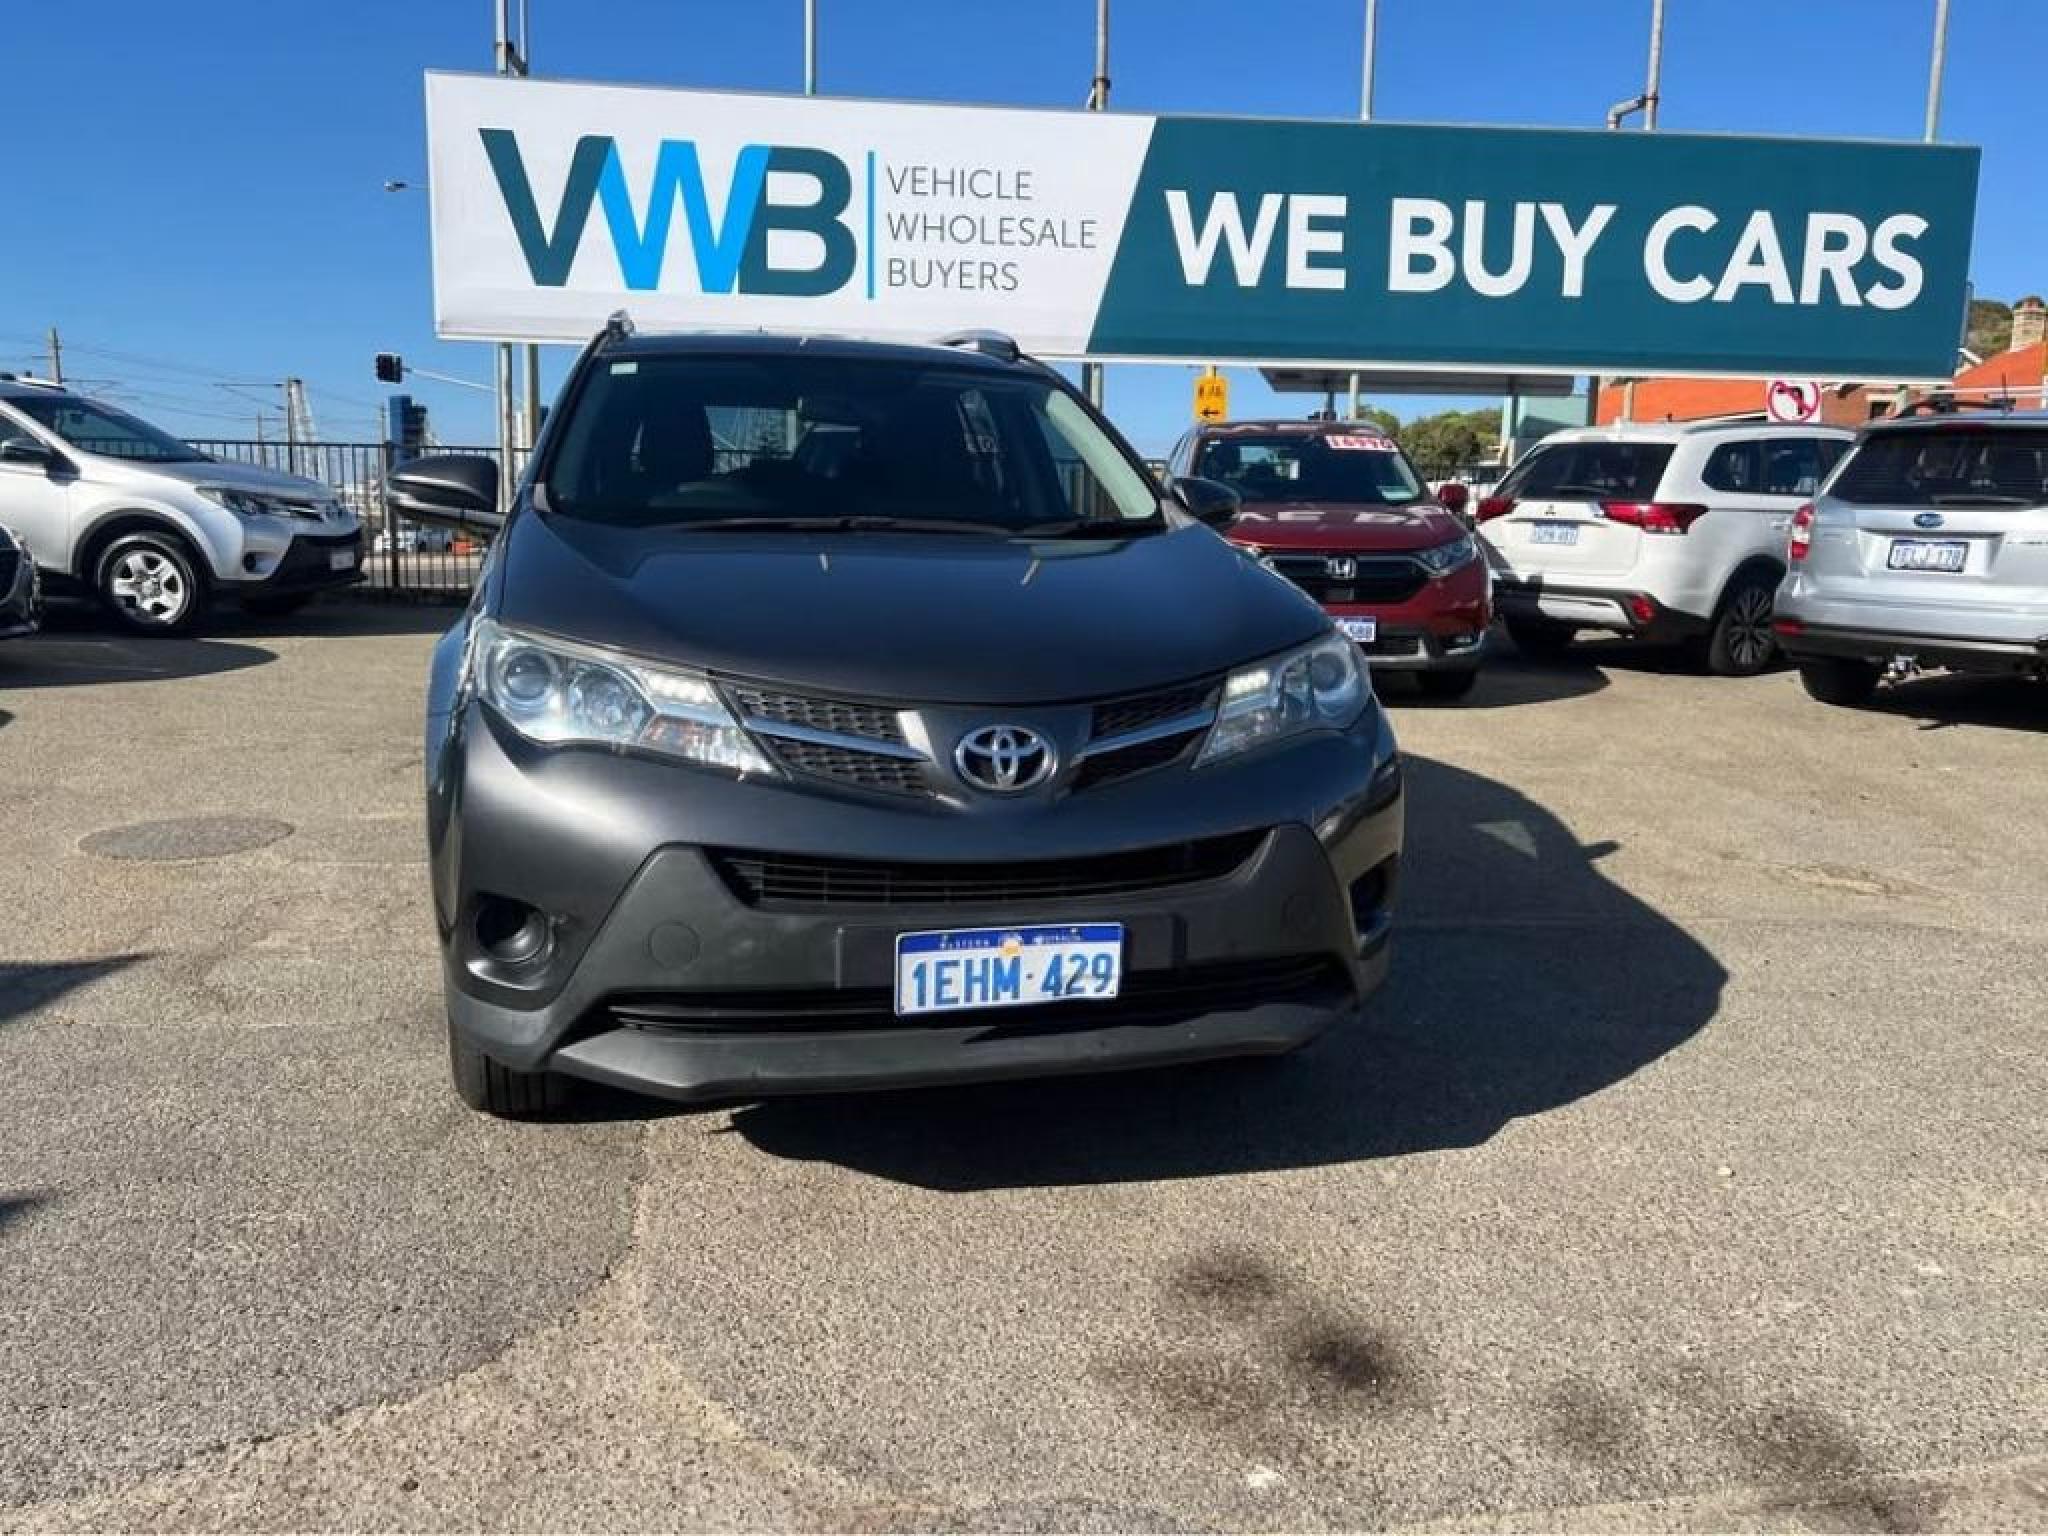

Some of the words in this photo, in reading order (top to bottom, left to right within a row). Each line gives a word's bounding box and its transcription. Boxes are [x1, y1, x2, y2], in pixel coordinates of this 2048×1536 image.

[886, 165, 1034, 202] VEHICLE
[478, 127, 858, 298] VWB
[886, 213, 1098, 249] WHOLESALE
[1165, 189, 1347, 290] WE
[1388, 197, 1617, 297] BUY
[1643, 205, 1929, 310] CARS
[887, 257, 1020, 292] BUYERS
